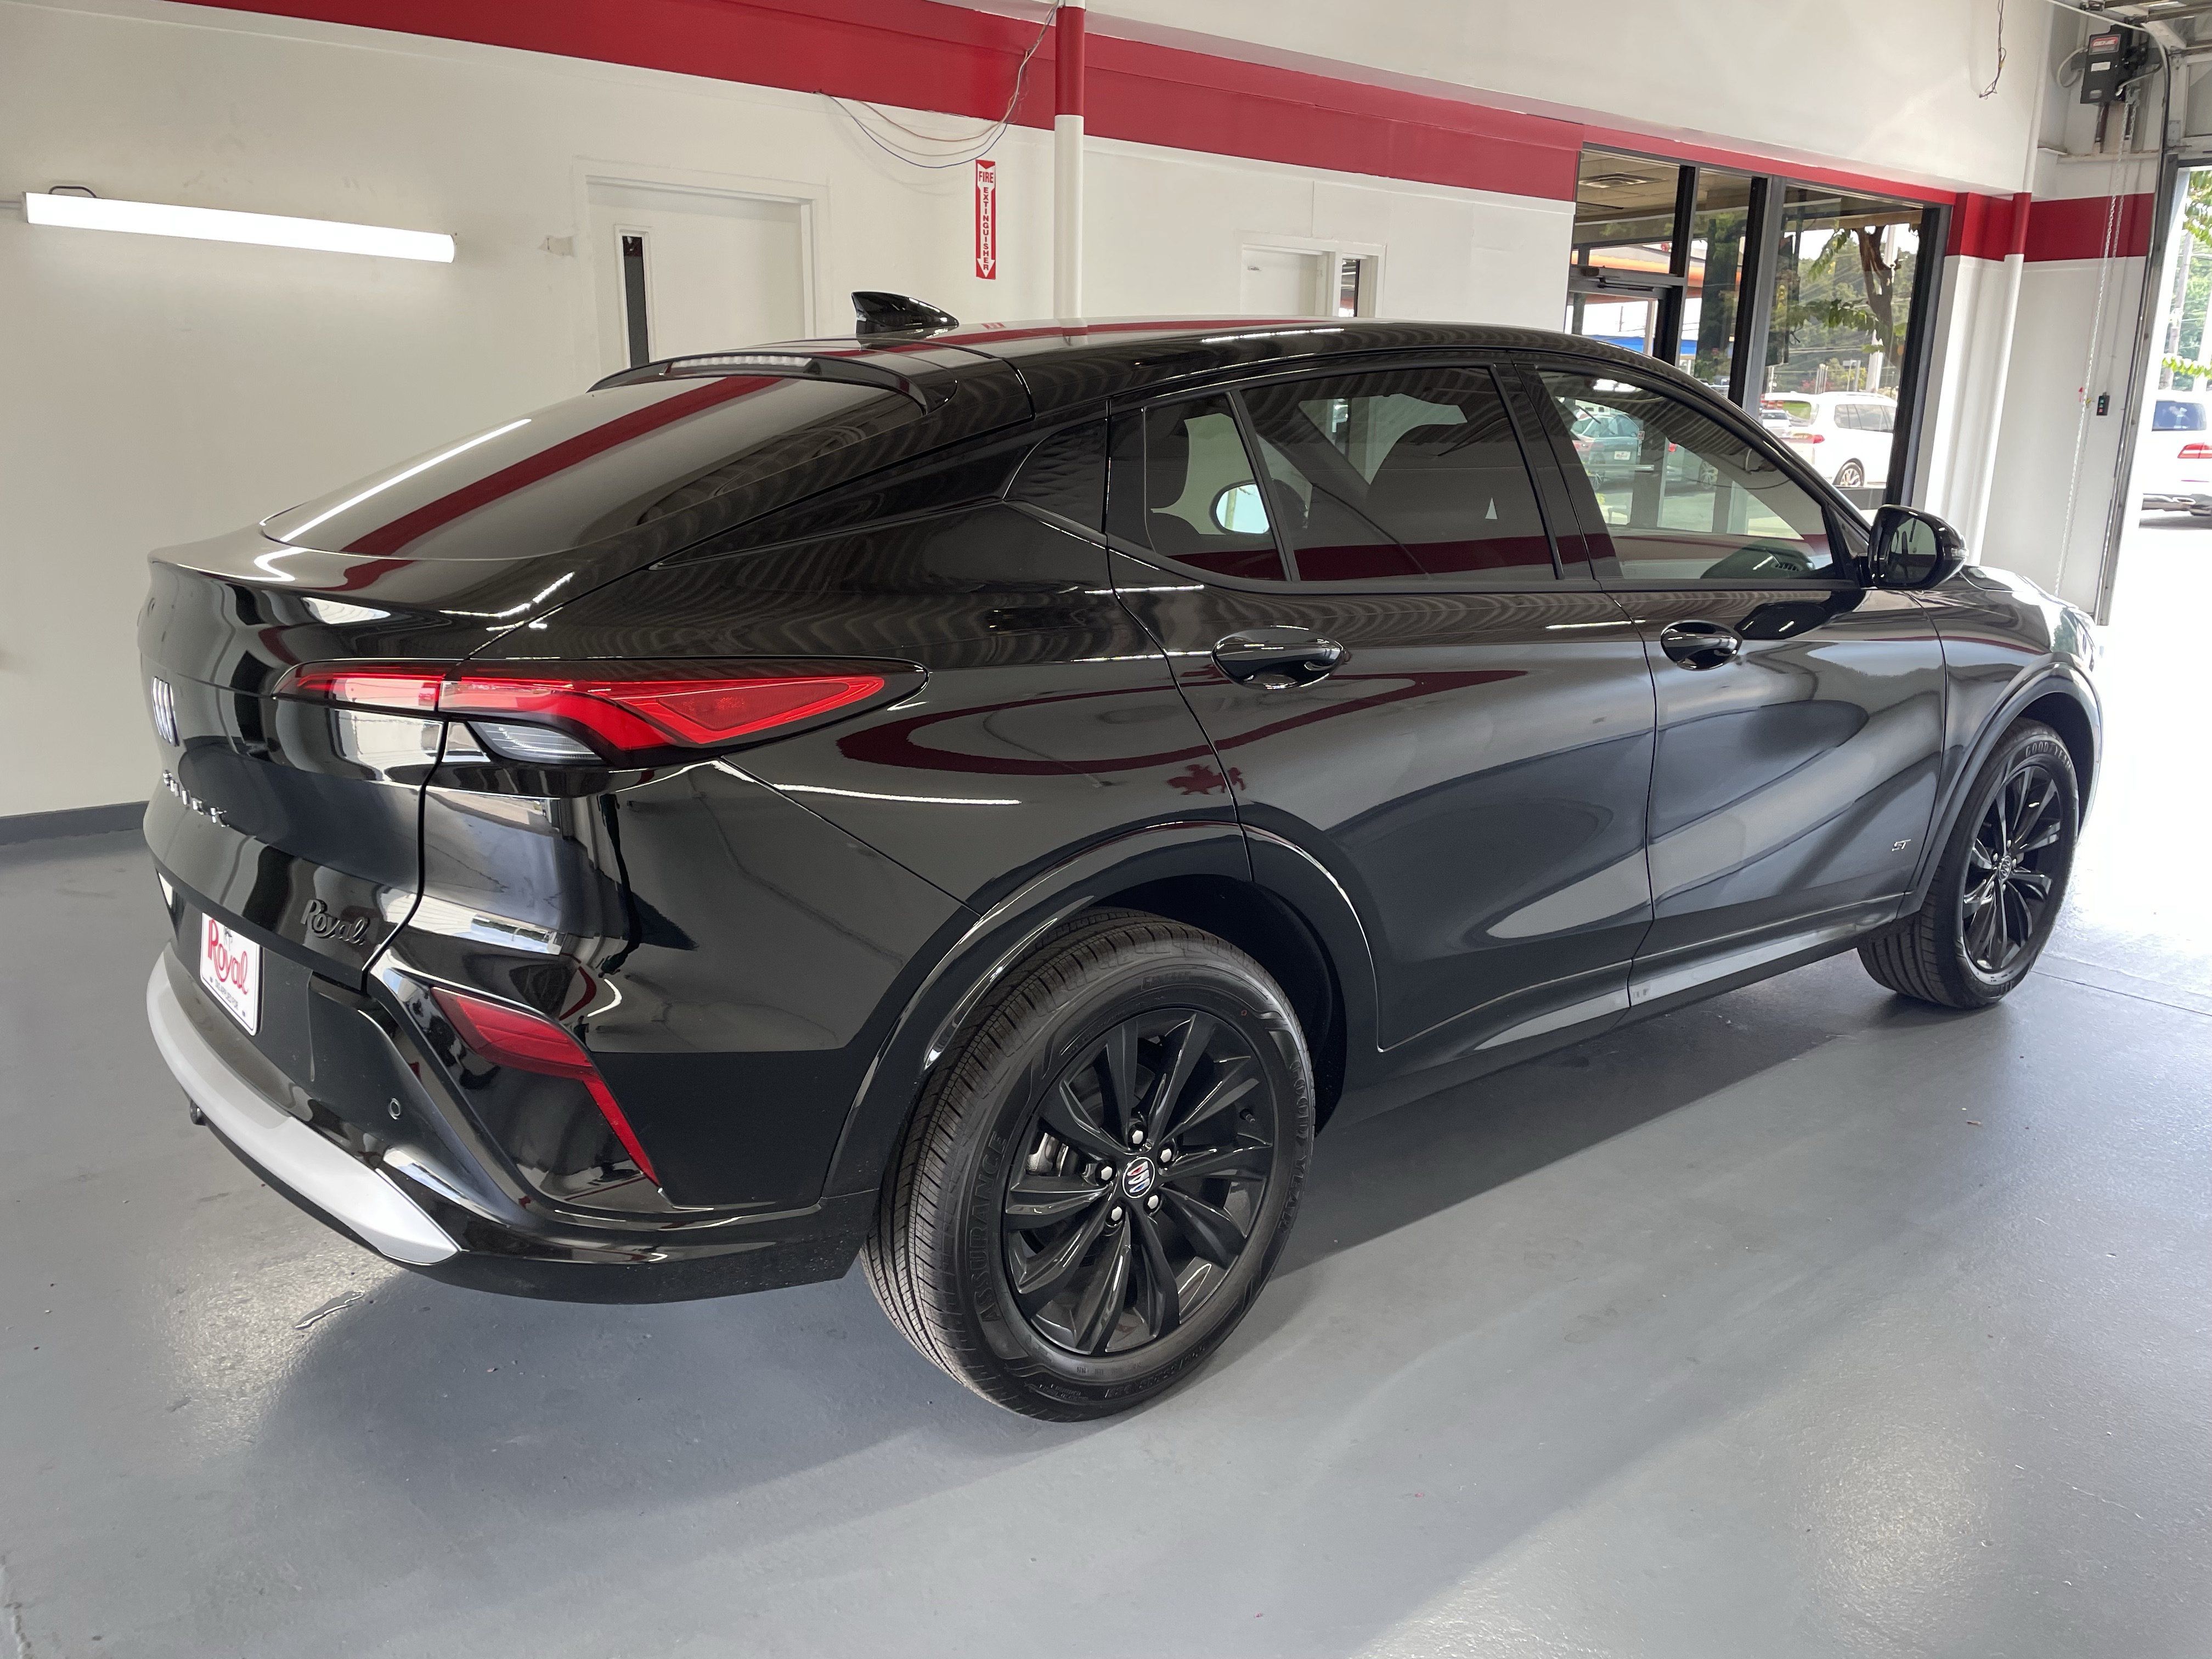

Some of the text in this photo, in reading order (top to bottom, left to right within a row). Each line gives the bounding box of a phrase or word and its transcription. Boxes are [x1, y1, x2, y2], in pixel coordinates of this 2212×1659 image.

[979, 171, 994, 183] FIRE
[1892, 839, 1911, 851] ST
[300, 899, 368, 944] Royal
[208, 919, 249, 995] Royal
[969, 1131, 1007, 1322] ASSURANCE
